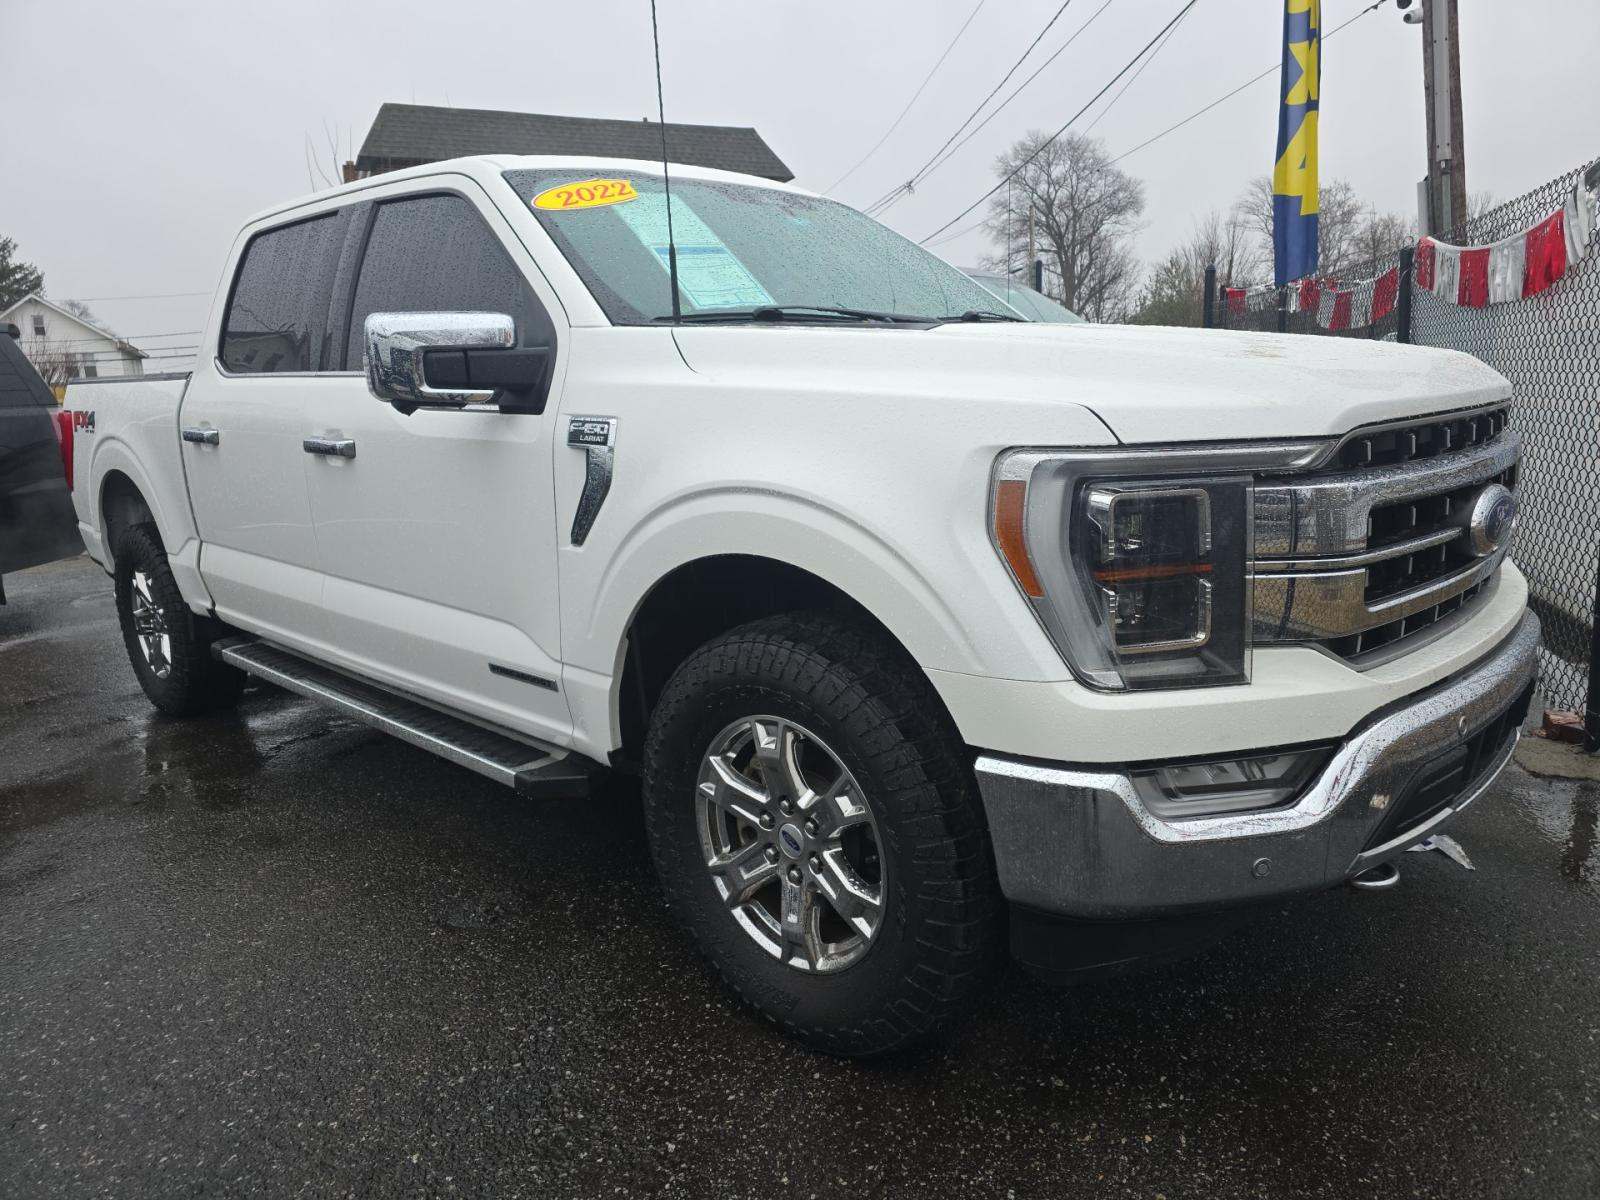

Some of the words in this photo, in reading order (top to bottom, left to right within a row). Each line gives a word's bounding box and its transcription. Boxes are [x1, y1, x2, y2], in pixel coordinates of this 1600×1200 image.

[556, 182, 632, 207] 2022
[73, 411, 96, 432] FX4
[579, 434, 605, 442] LARIAT
